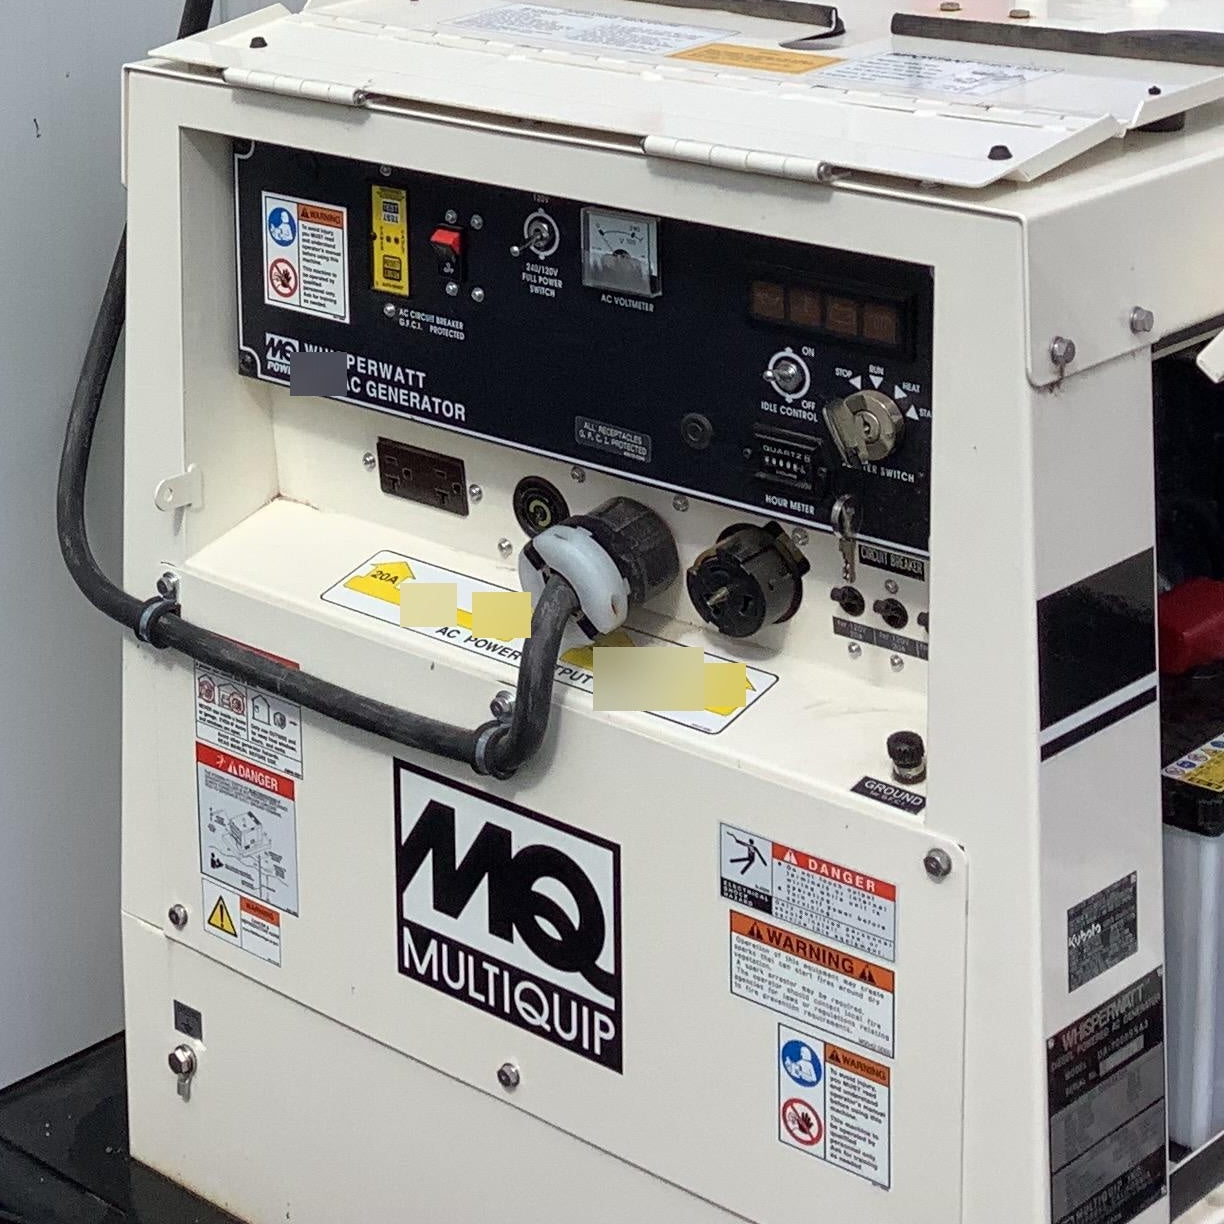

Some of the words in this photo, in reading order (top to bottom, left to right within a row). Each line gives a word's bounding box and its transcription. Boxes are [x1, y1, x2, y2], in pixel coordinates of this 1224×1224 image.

[522, 272, 537, 284] FULL
[538, 275, 563, 288] POWER
[526, 262, 558, 277] 240/120V
[529, 285, 555, 297] SWITCH
[600, 294, 612, 304] AC
[614, 296, 654, 312] VOLTMETER
[399, 308, 409, 318] AC
[410, 310, 435, 323] CIRCUIT
[436, 315, 464, 330] BREAKER
[429, 324, 465, 341] PROTECTED
[801, 346, 815, 358] ON
[267, 360, 291, 375] POW
[835, 367, 853, 378] STOP
[869, 364, 885, 376] RUN
[902, 382, 921, 394] HEAT
[366, 381, 466, 422] GENERATOR
[760, 401, 778, 414] IDLE
[779, 405, 819, 423] CONTROL
[801, 399, 816, 411] OFF
[598, 425, 643, 445] RECEPTACLES
[611, 438, 647, 456] PROTECTED
[762, 444, 802, 459] QUARTZ
[880, 466, 915, 484] SWITCH
[765, 494, 789, 508] HOUR
[789, 500, 815, 516] METER
[861, 545, 888, 566] CIRCUIT
[890, 553, 923, 575] BREAKER
[371, 569, 399, 586] 20A
[435, 626, 461, 643] AC
[464, 635, 522, 662] POWER
[553, 664, 594, 685] TPUT
[238, 763, 278, 793] DANGER
[865, 780, 923, 806] GROUND
[808, 857, 875, 893] DANGER
[400, 798, 616, 999] MQ
[722, 878, 768, 902] ELECTRICAL
[1068, 922, 1102, 949] Kubota
[765, 926, 854, 976] WARNING
[402, 926, 616, 1056] MULTIQUIP
[1061, 981, 1144, 1053] WHISPERWATT
[842, 1054, 887, 1082] WARNING
